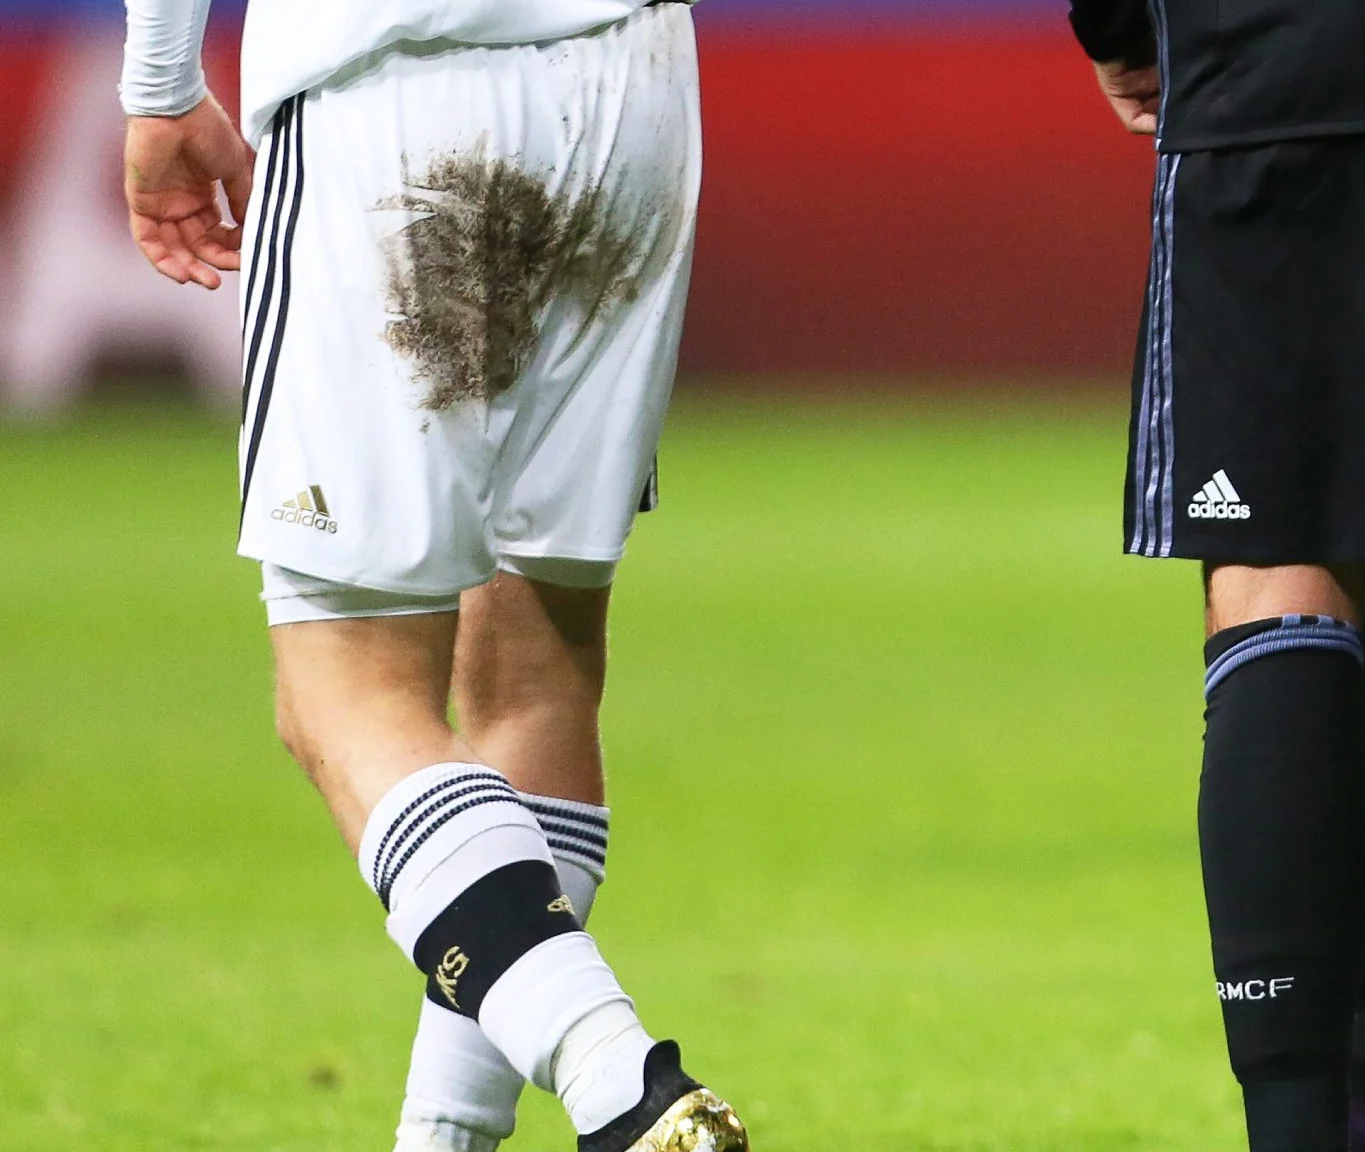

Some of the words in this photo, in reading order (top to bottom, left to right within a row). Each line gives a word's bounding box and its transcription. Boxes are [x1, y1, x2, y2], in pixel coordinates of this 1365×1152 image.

[270, 508, 339, 535] adidas
[1187, 499, 1251, 519] adidas
[1215, 976, 1295, 1001] RMCF
